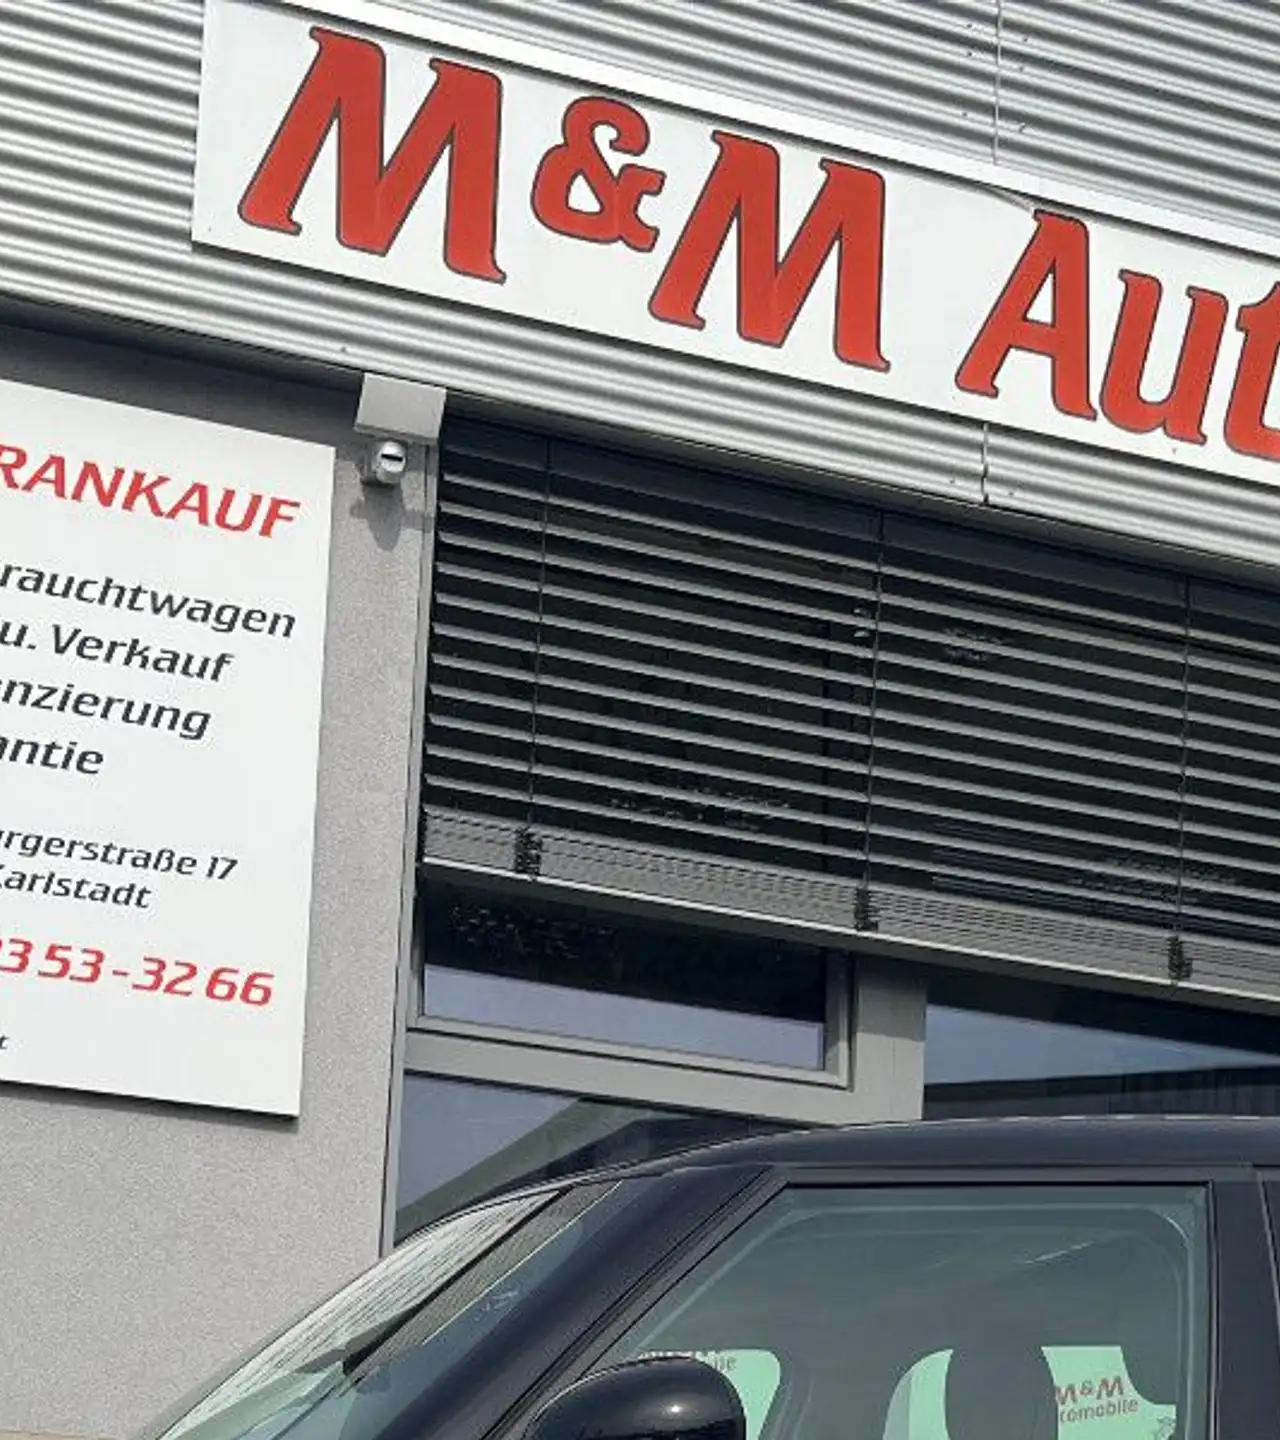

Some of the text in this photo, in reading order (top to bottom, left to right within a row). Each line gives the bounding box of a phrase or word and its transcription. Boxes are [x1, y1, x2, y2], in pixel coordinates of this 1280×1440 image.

[238, 26, 891, 371] M&M
[52, 624, 235, 682] Verkauf
[206, 856, 238, 881] 17
